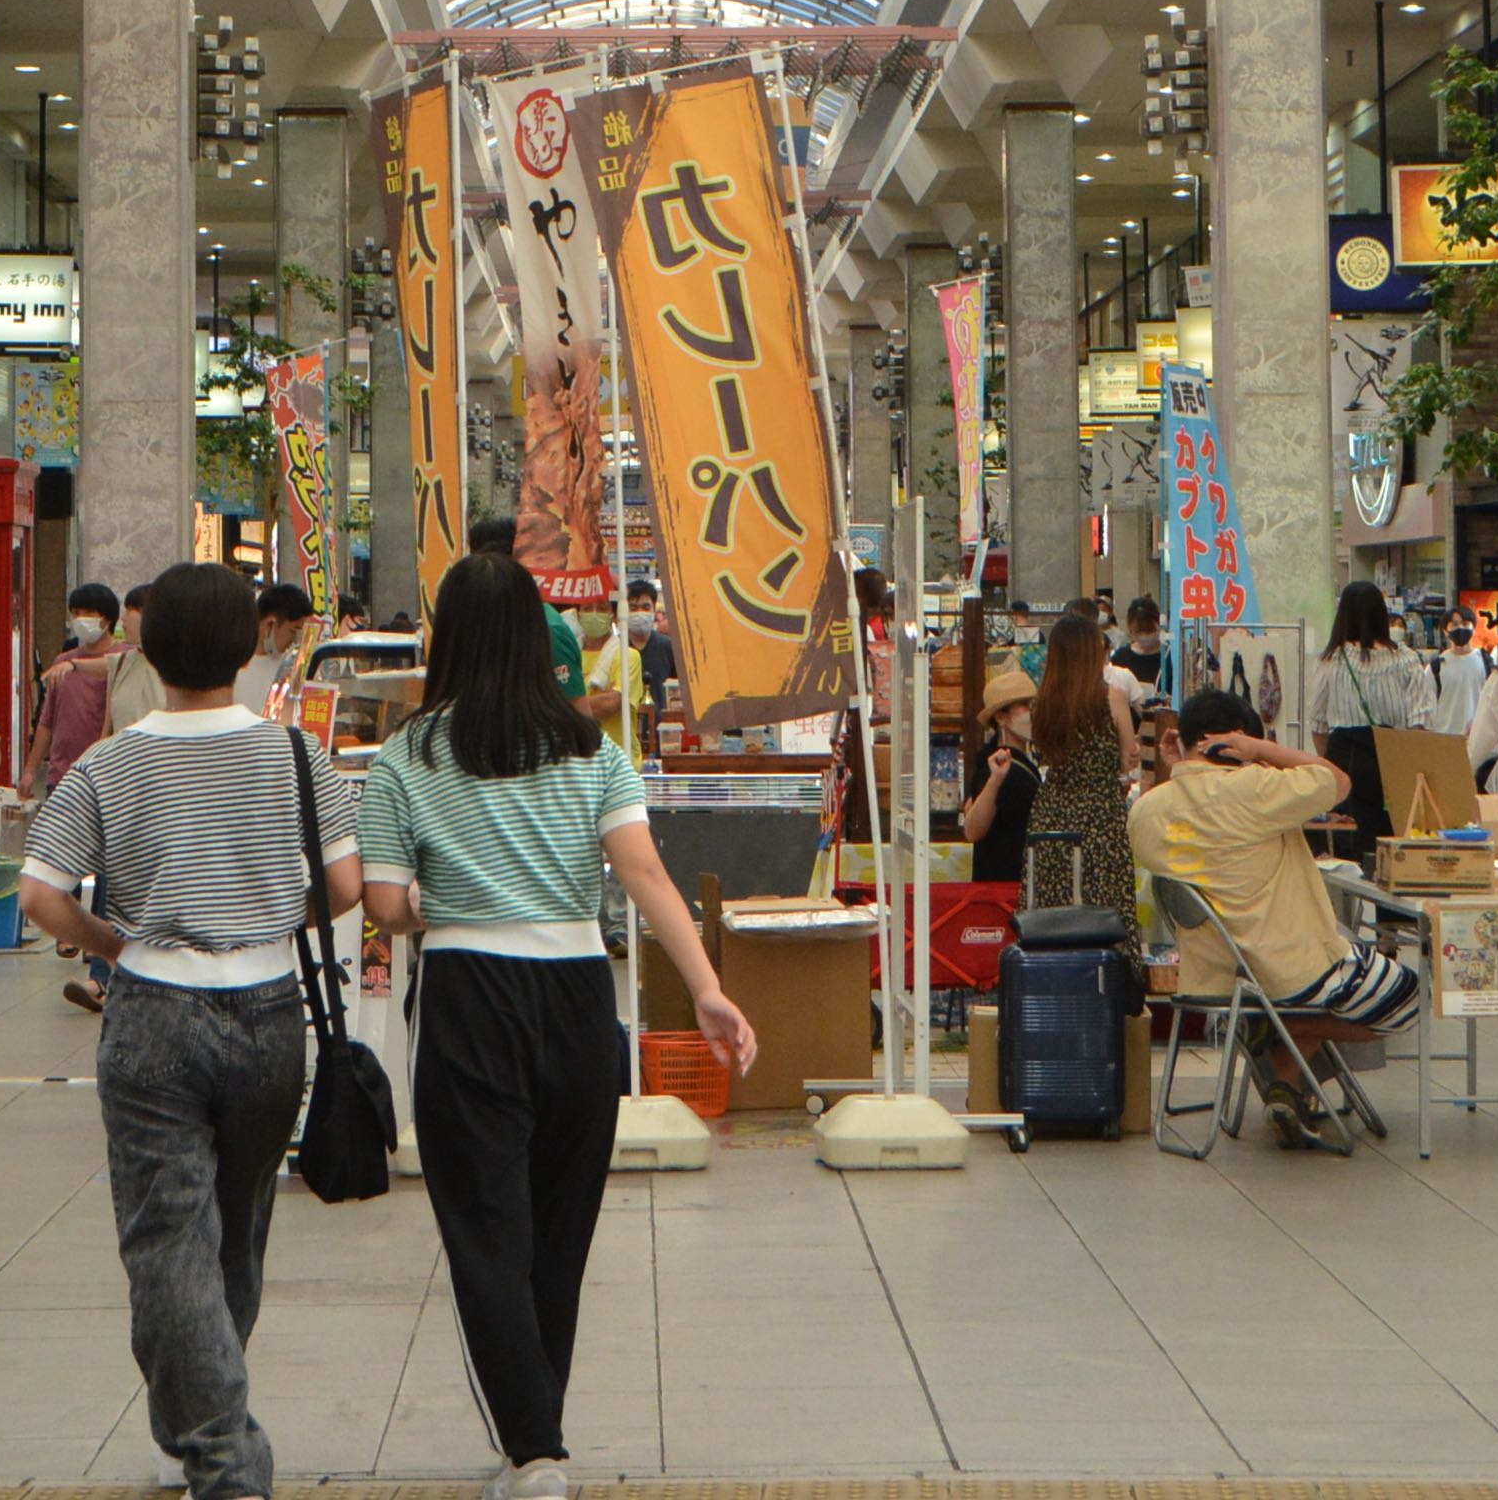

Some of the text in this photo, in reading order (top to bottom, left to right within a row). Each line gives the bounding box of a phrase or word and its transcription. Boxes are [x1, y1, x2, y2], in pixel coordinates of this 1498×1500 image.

[7, 272, 66, 288] 石手の湯
[33, 303, 65, 318] inn
[1169, 379, 1207, 416] 販売中
[1175, 425, 1218, 622] カブト虫
[1199, 430, 1245, 624] クワガタ
